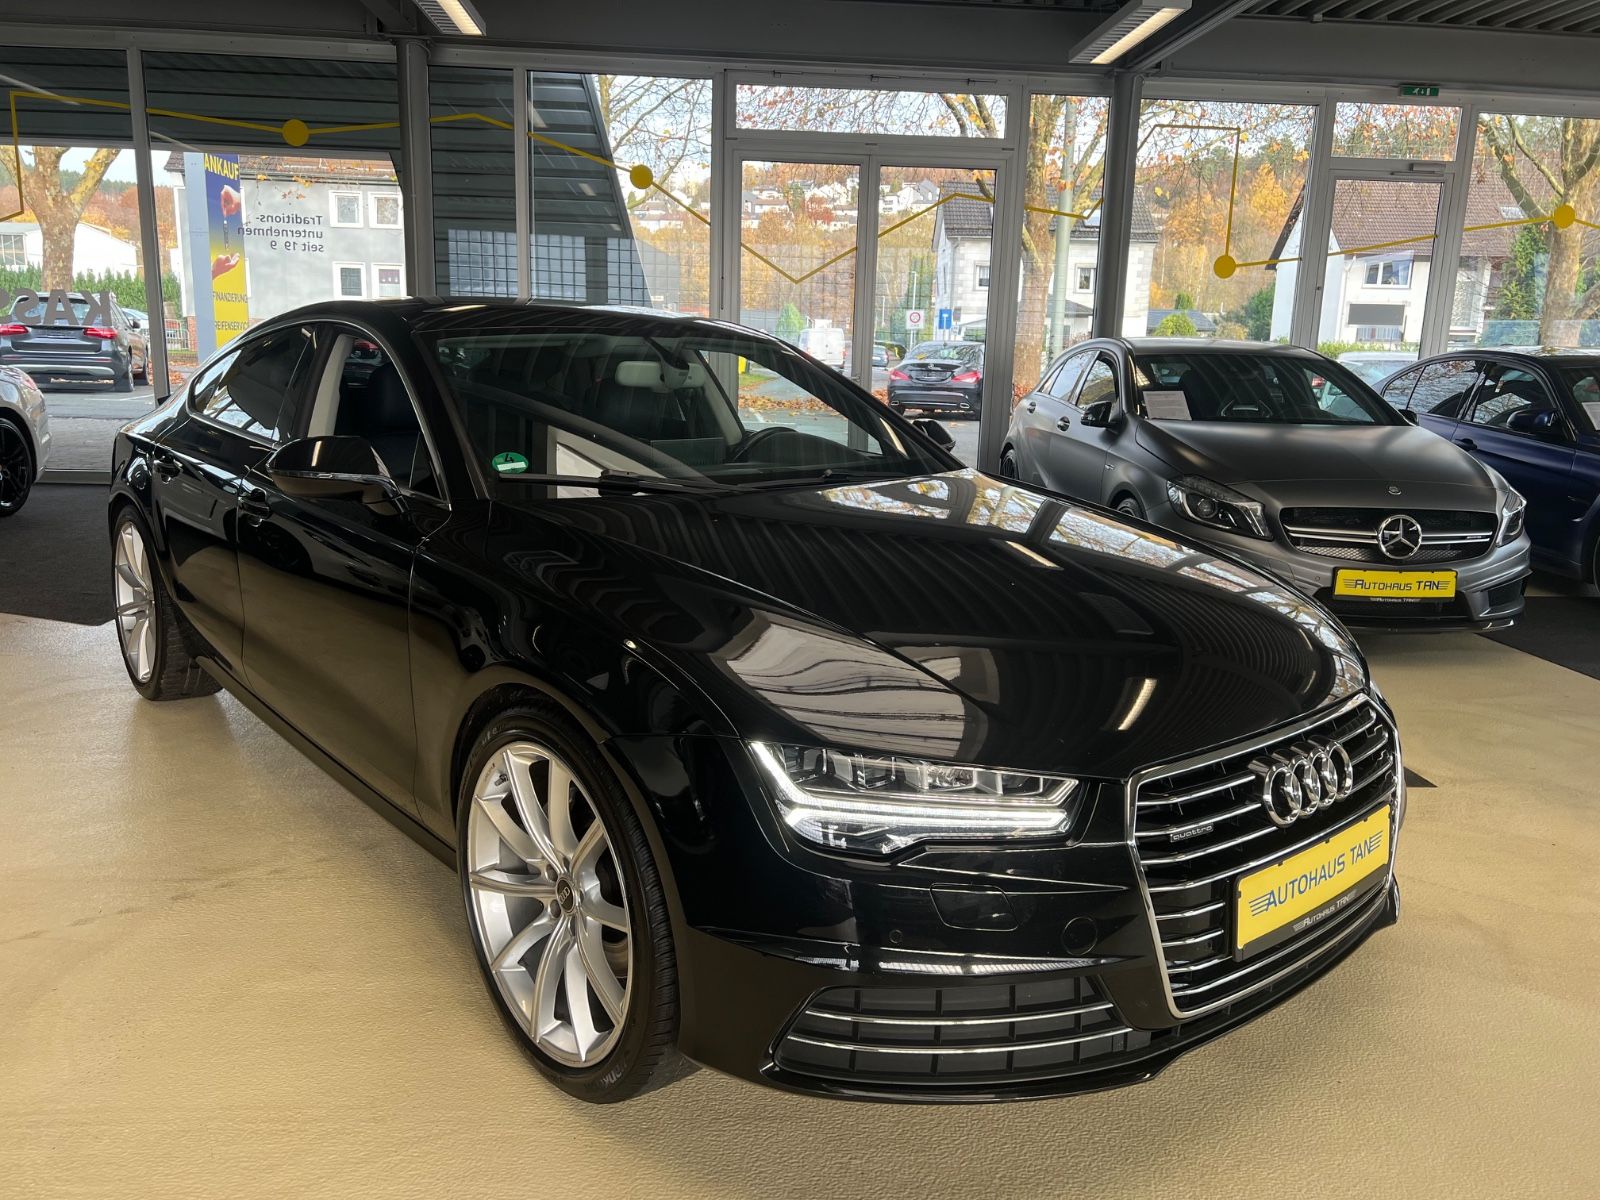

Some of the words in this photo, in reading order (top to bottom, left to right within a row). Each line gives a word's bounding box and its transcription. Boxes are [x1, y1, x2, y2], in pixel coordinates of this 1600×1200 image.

[204, 153, 239, 180] ANKAUF
[1416, 580, 1440, 590] TAN
[1173, 825, 1213, 841] quattro
[1265, 853, 1346, 911] AUTOHAUS
[1349, 839, 1374, 866] TAN
